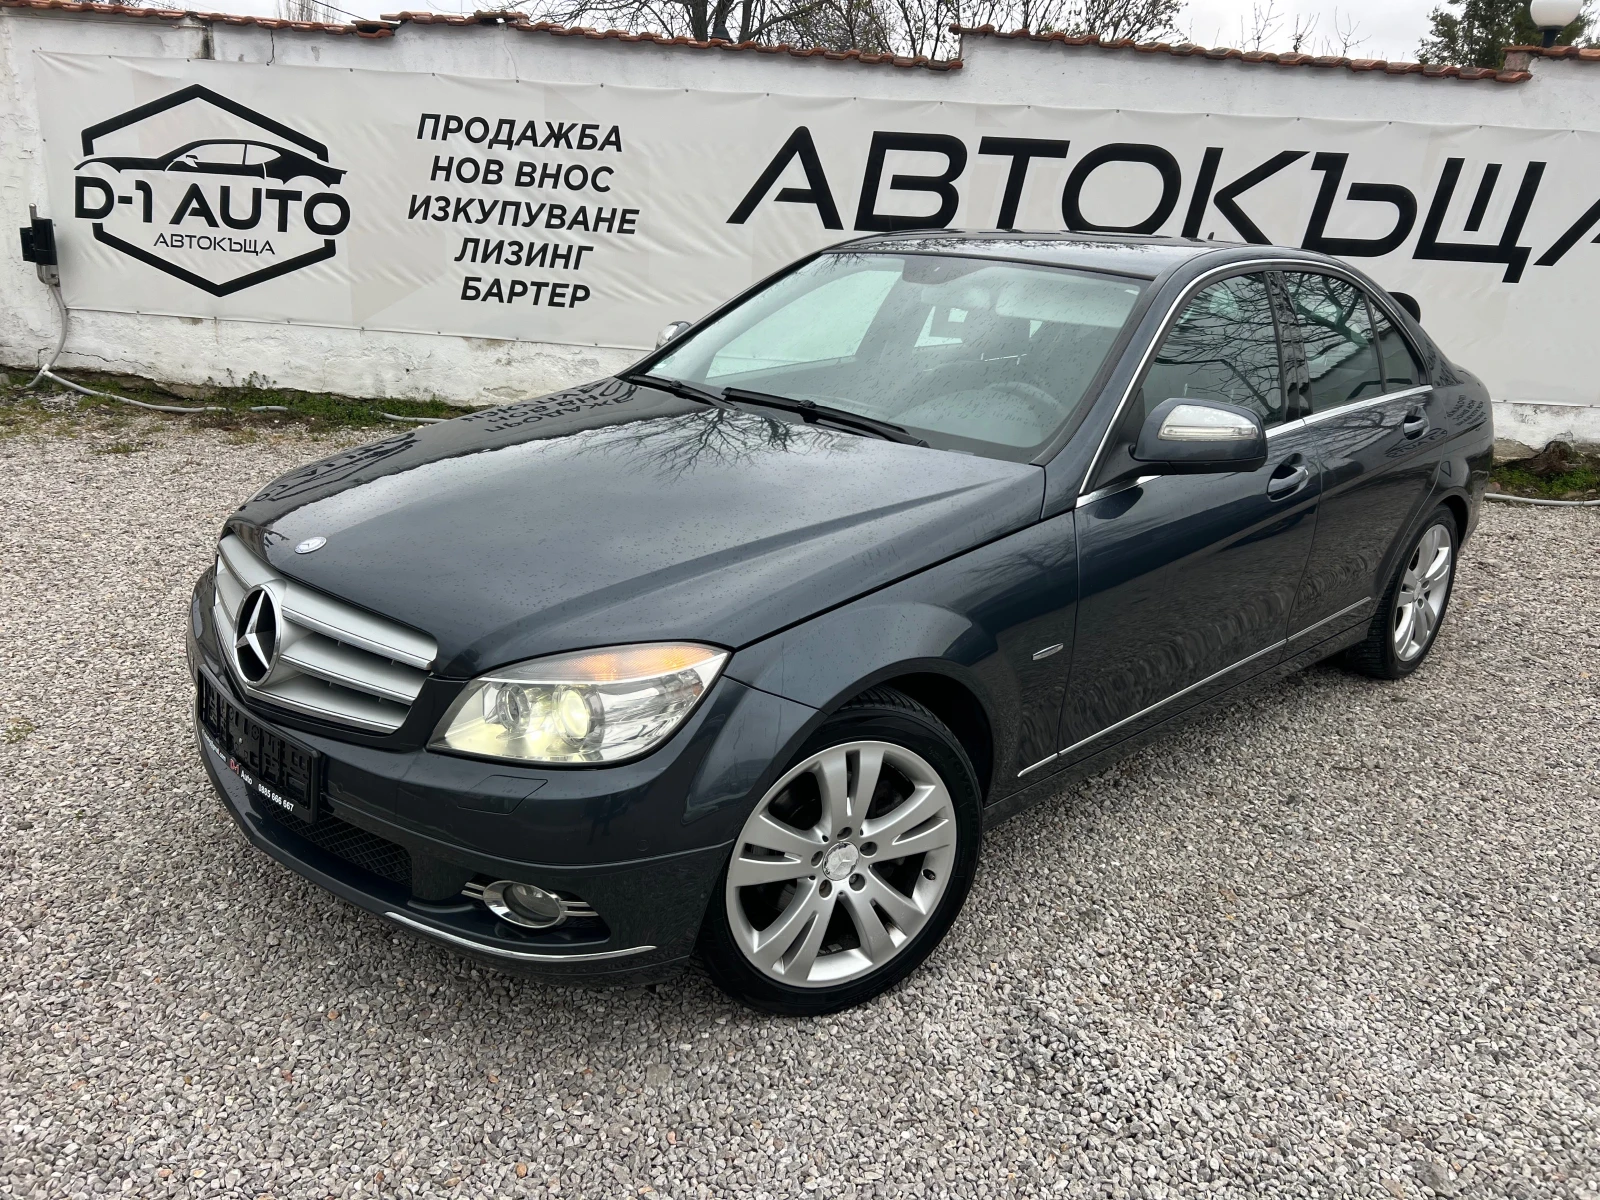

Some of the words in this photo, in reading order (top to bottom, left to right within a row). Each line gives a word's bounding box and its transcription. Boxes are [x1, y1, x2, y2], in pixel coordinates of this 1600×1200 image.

[416, 113, 623, 153] ПРОДАЖБА
[430, 155, 505, 185] НОВ
[514, 160, 615, 193] ВНОС
[73, 175, 154, 224] D-1
[168, 182, 351, 236] AUTO
[407, 194, 641, 235] ИЗКУПУВАНЕ
[153, 232, 276, 257] АВТОКЪЩА
[453, 237, 594, 271] ЛИЗИНГ
[460, 276, 591, 309] БАРТЕР
